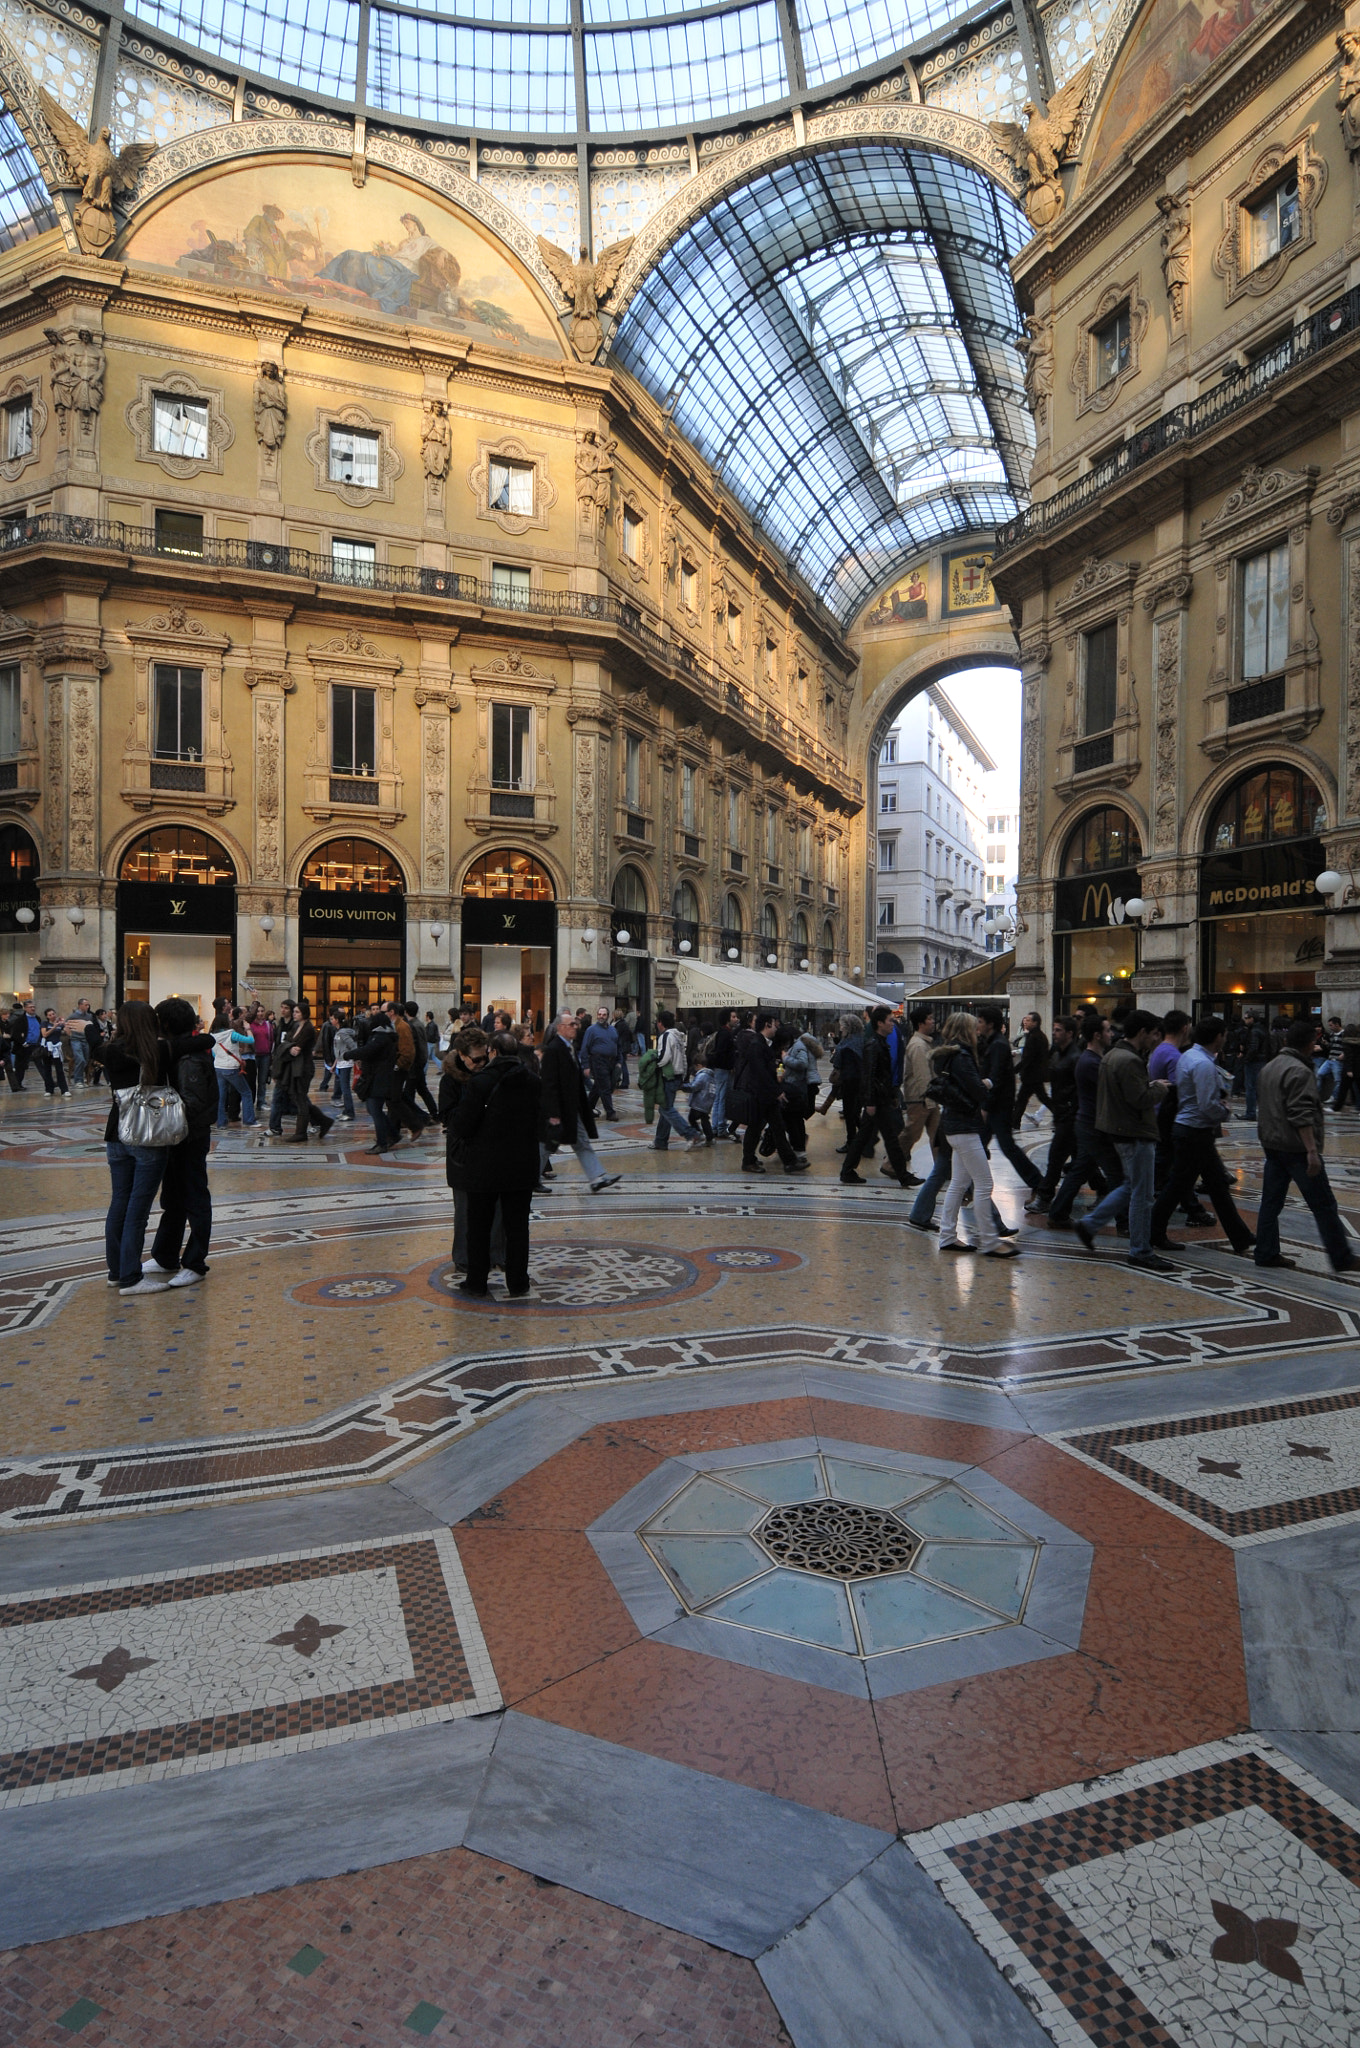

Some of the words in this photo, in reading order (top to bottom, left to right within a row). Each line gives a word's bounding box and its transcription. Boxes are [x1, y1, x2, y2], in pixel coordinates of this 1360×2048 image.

[1209, 879, 1316, 905] McDonald's
[309, 908, 344, 919] LOUIS
[346, 909, 396, 921] VUITTON
